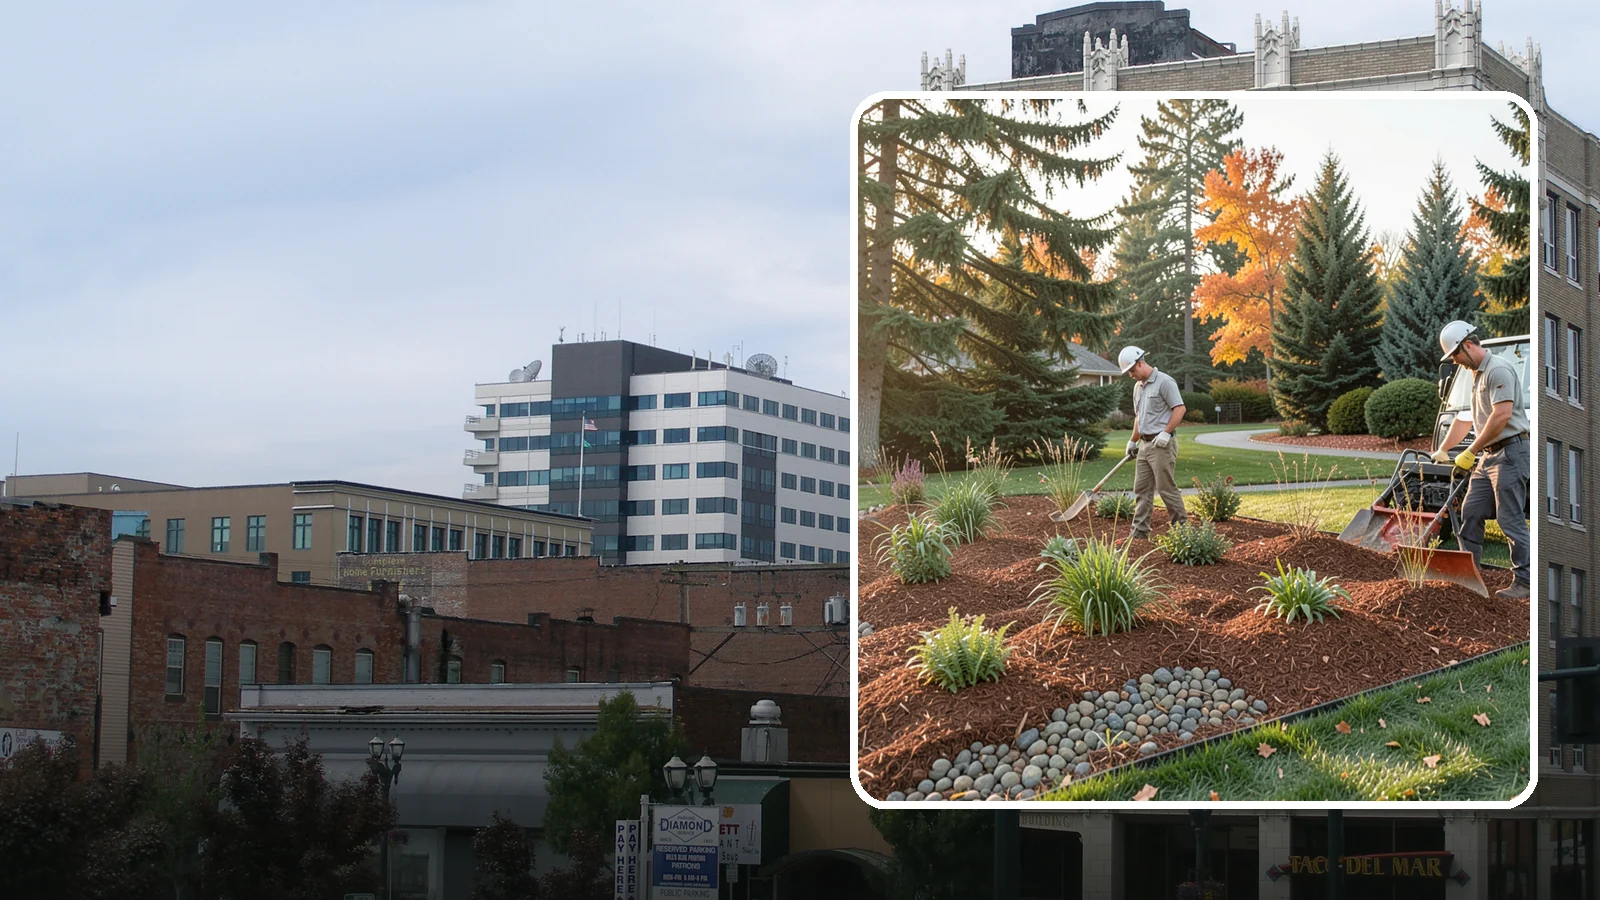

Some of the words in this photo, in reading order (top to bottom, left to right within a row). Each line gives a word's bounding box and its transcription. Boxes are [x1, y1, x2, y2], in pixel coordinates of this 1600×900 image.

[343, 568, 367, 577] Home
[370, 567, 427, 577] Furnishers
[660, 818, 713, 832] DIAMOND
[1022, 815, 1070, 828] BUILDING
[617, 825, 625, 852] PAY
[628, 824, 637, 852] PAY
[656, 845, 688, 853] RESERVED
[689, 846, 716, 854] PARKING
[721, 851, 739, 862] Soup
[671, 862, 701, 870] PATRONS
[1346, 855, 1385, 876] DEL
[1392, 857, 1442, 877] MAR
[617, 856, 625, 893] HERE
[627, 856, 637, 893] HERE
[660, 888, 682, 897] PUBLIC
[683, 889, 710, 898] PARKING
